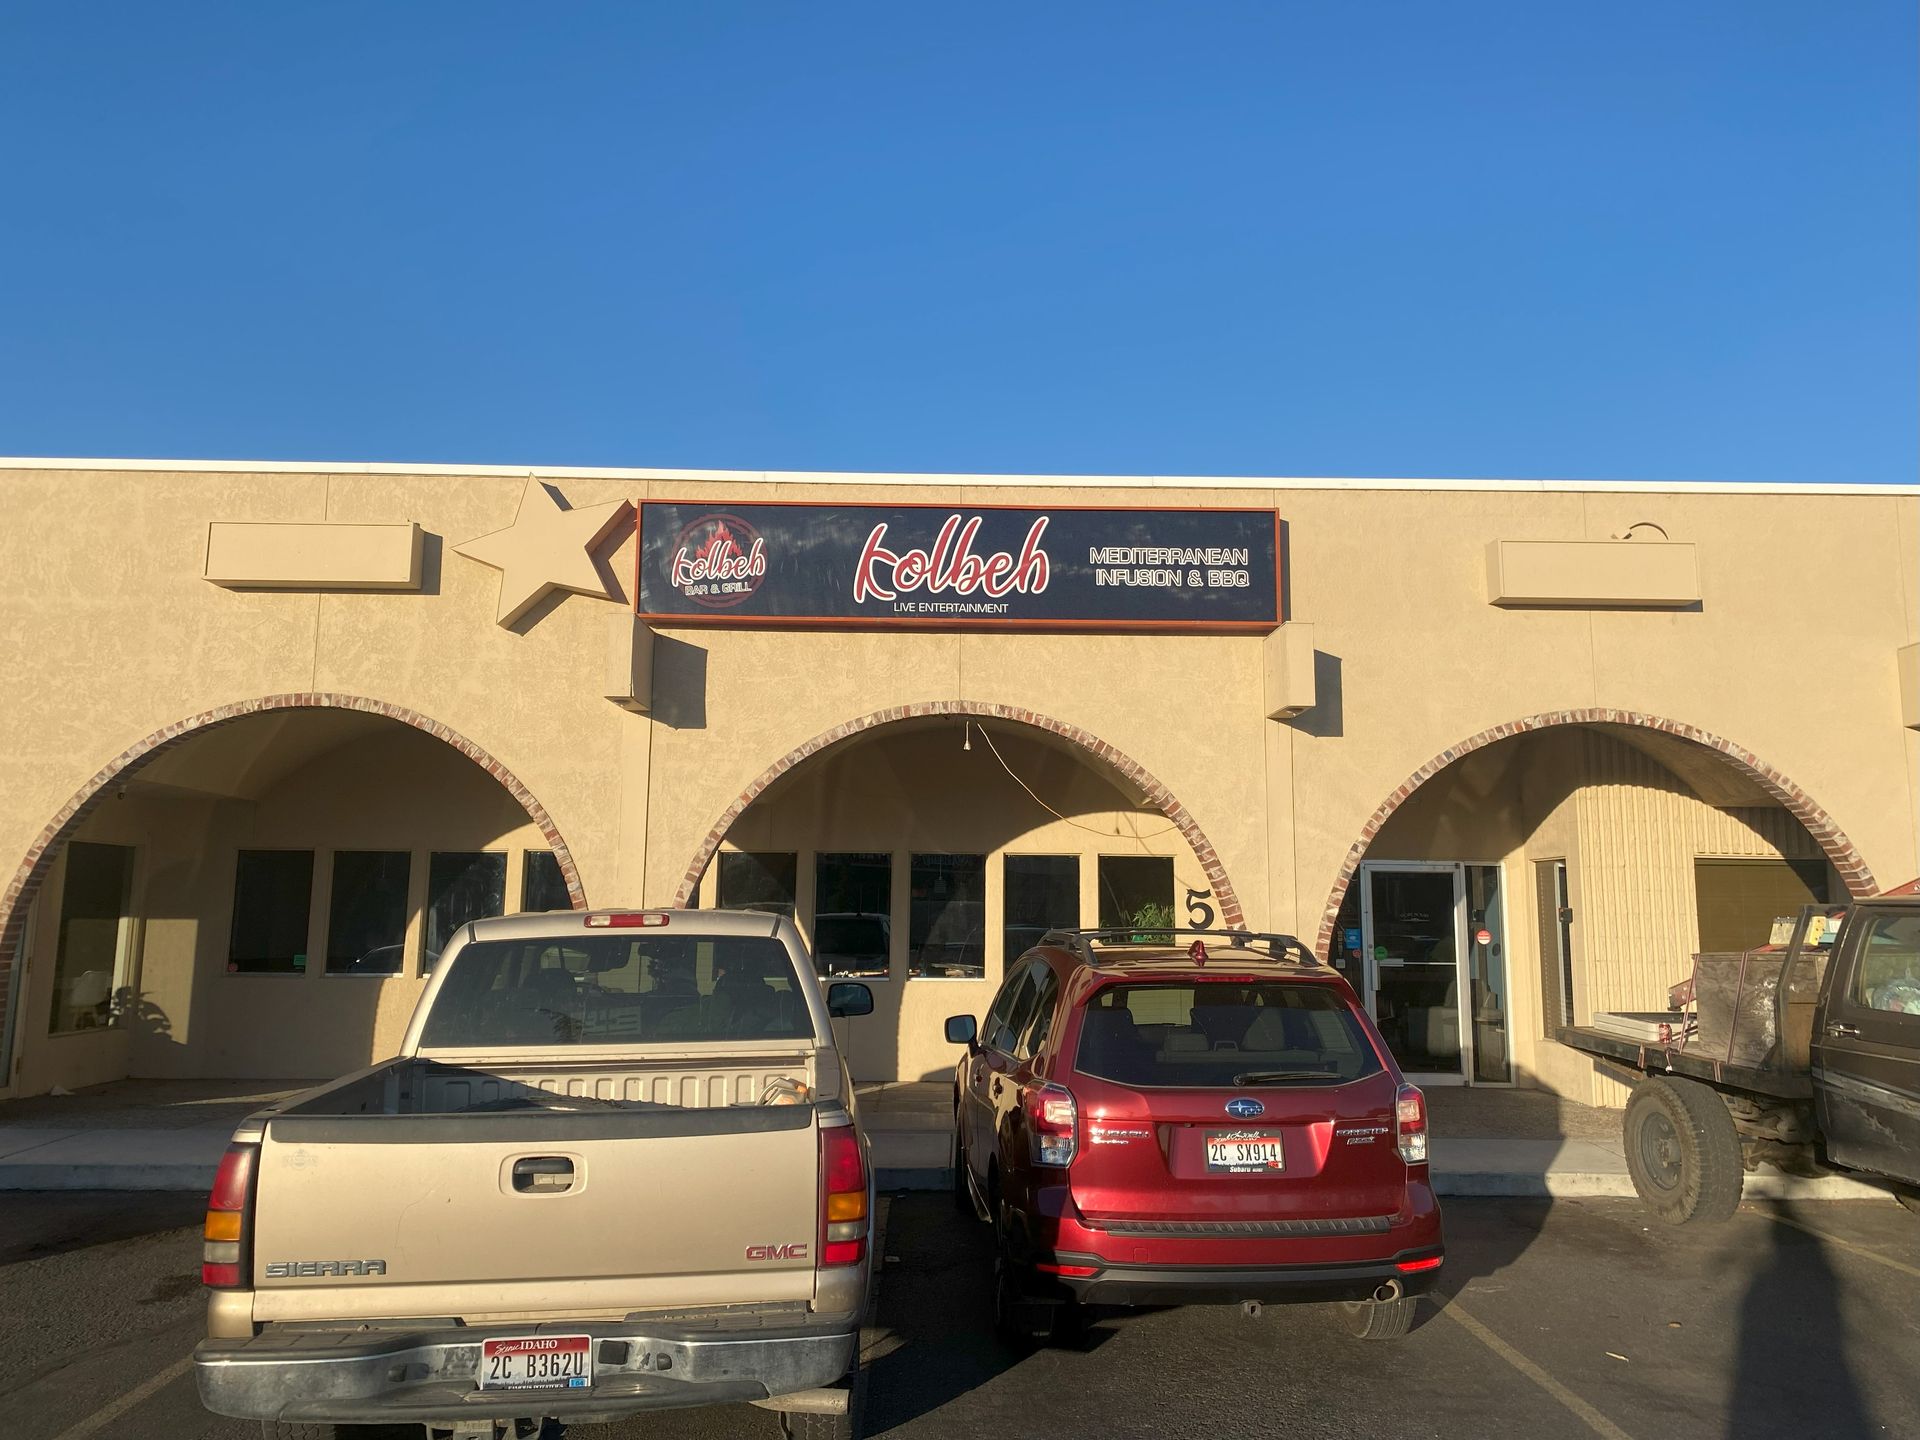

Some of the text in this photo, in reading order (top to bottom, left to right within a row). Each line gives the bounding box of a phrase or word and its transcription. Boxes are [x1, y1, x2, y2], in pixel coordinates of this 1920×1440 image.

[854, 514, 1050, 603] Kolbeh
[1089, 547, 1248, 565] MEDITERRANEAN
[1095, 569, 1249, 587] INFUSION & BBQ
[684, 582, 752, 595] BAR & GRILL
[893, 602, 1009, 613] LIVE ENTERTAINMENT
[1185, 888, 1215, 930] 5
[1211, 1143, 1277, 1161] 2C SX914
[746, 1243, 808, 1260] GMC
[265, 1260, 386, 1278] SIERRA
[520, 1339, 558, 1350] IDAHO
[490, 1352, 584, 1379] 2C B362U
